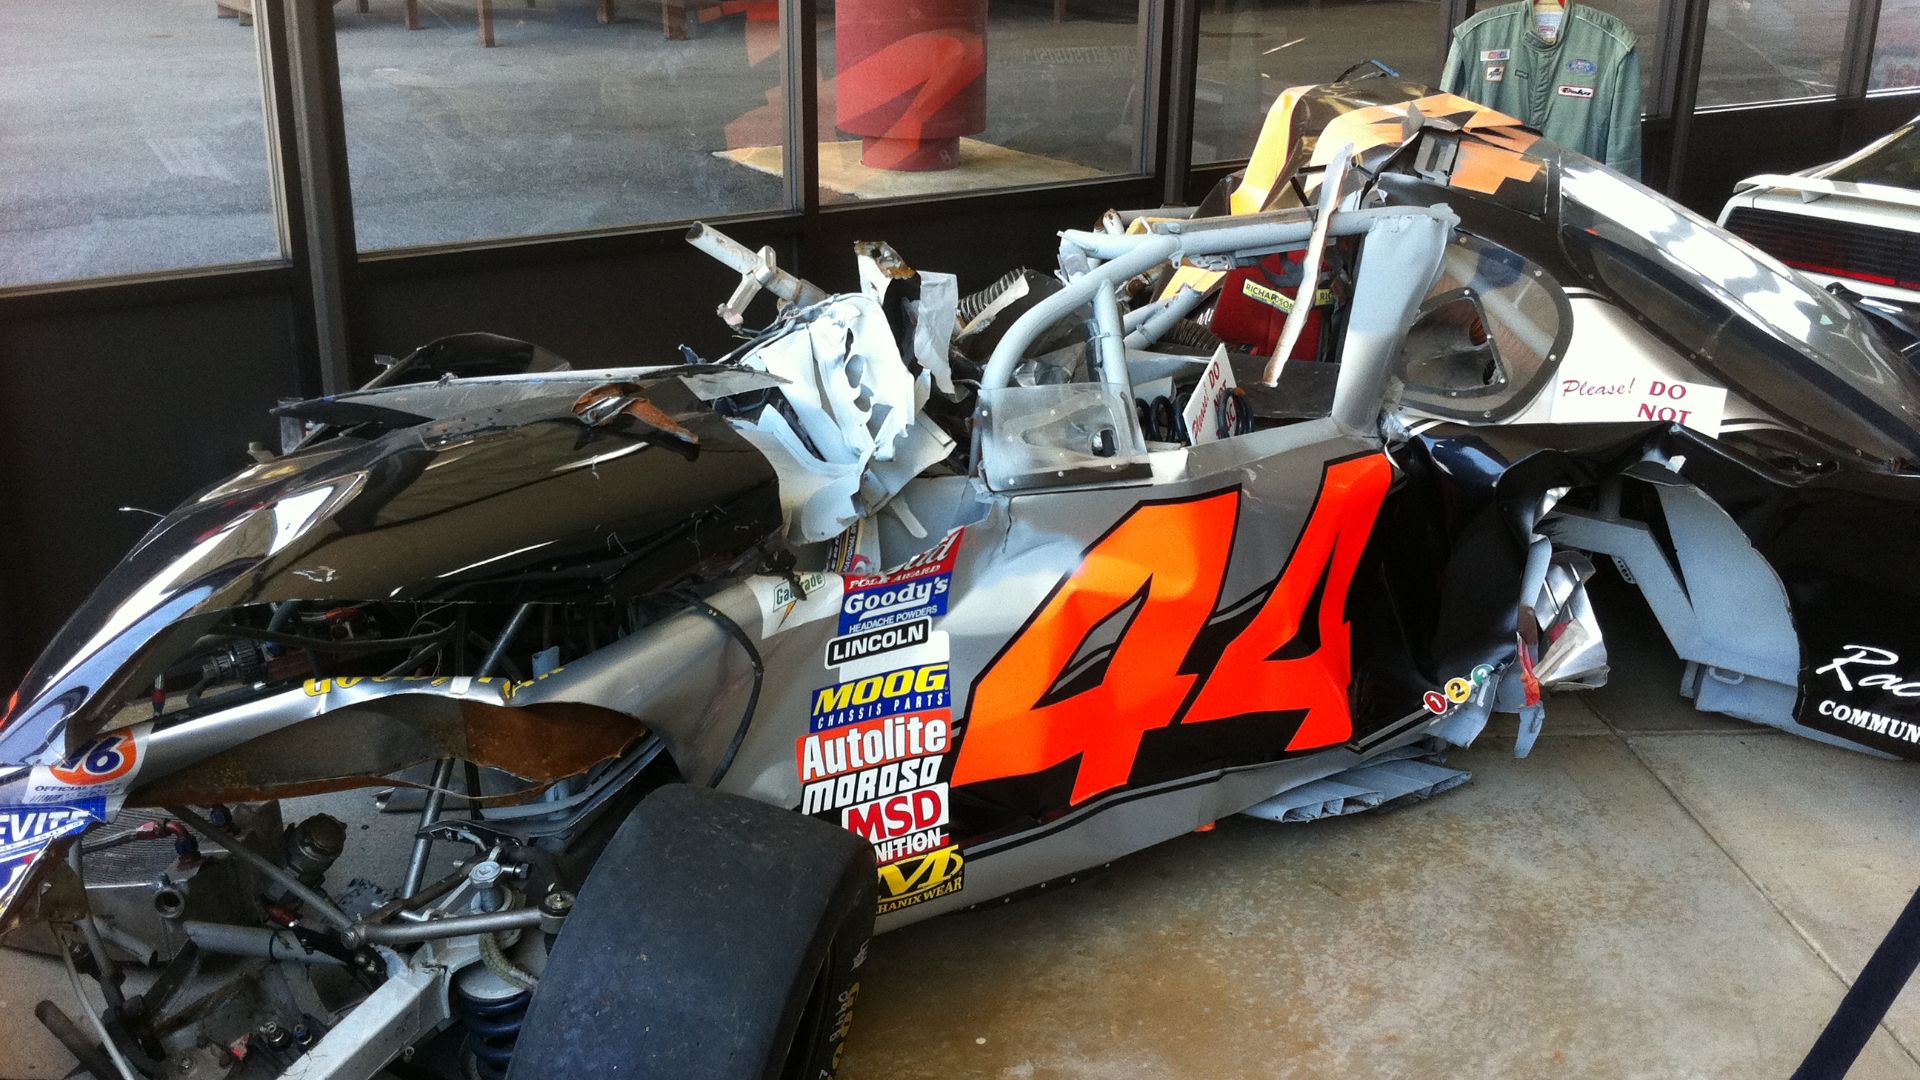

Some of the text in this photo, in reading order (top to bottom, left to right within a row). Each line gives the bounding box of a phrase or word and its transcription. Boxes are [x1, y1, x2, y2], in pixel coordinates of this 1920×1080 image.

[1562, 377, 1687, 400] Please! DO
[1637, 403, 1692, 426] NOT
[776, 573, 823, 605] Garade
[844, 576, 949, 616] Goody's
[848, 604, 938, 635] HEADACHE POWDERS
[950, 452, 1393, 806] 44
[833, 624, 924, 661] LINCOLN
[813, 664, 948, 716] MOOG
[818, 693, 944, 729] CHASSIS PARTS
[803, 716, 947, 780] Autolite
[848, 789, 942, 841] MSD
[923, 876, 963, 902] WEAR
